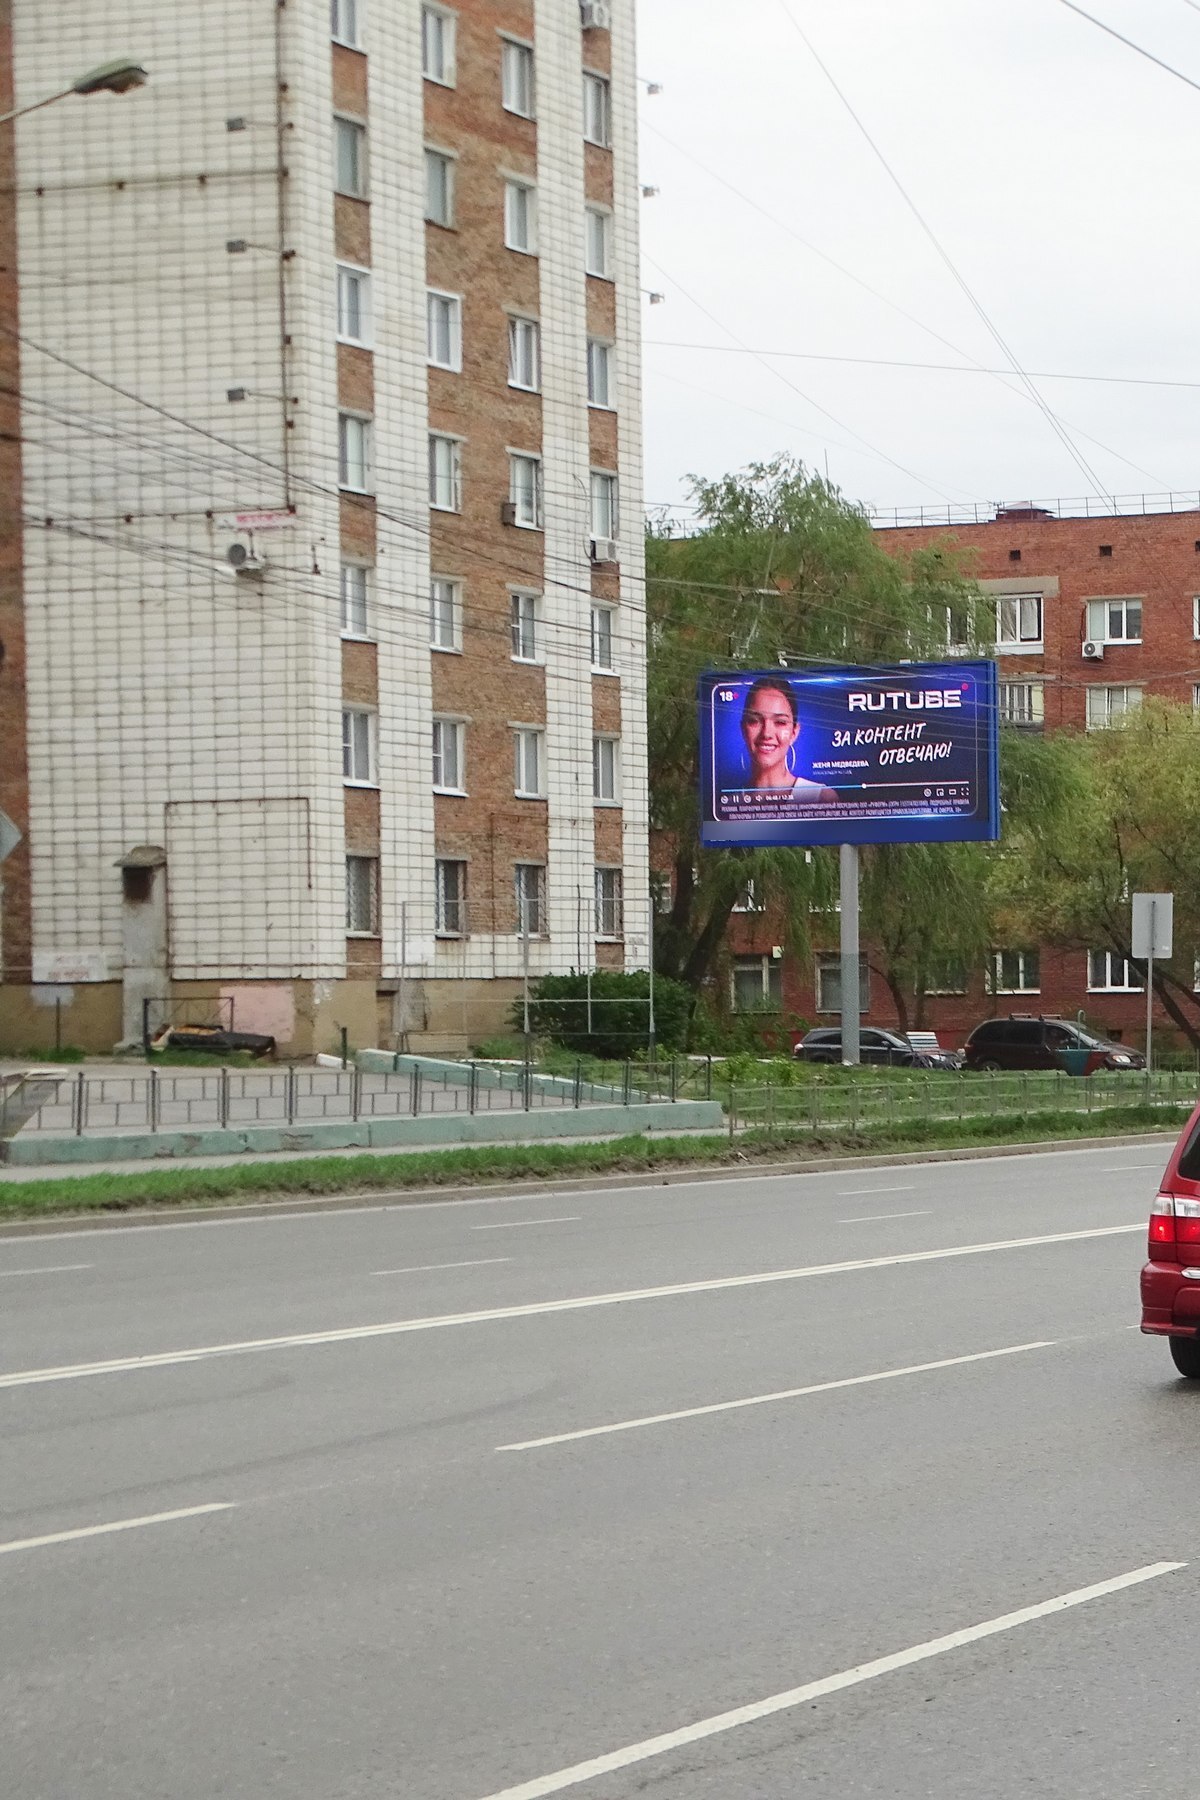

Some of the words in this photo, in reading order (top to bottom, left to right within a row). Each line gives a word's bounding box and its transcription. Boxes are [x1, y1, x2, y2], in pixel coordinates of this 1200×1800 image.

[848, 689, 962, 712] RUTUBE
[831, 730, 851, 748] ЗА
[854, 722, 927, 746] КОНТЕНТ
[879, 741, 953, 766] ОТВЕЧАЮ!
